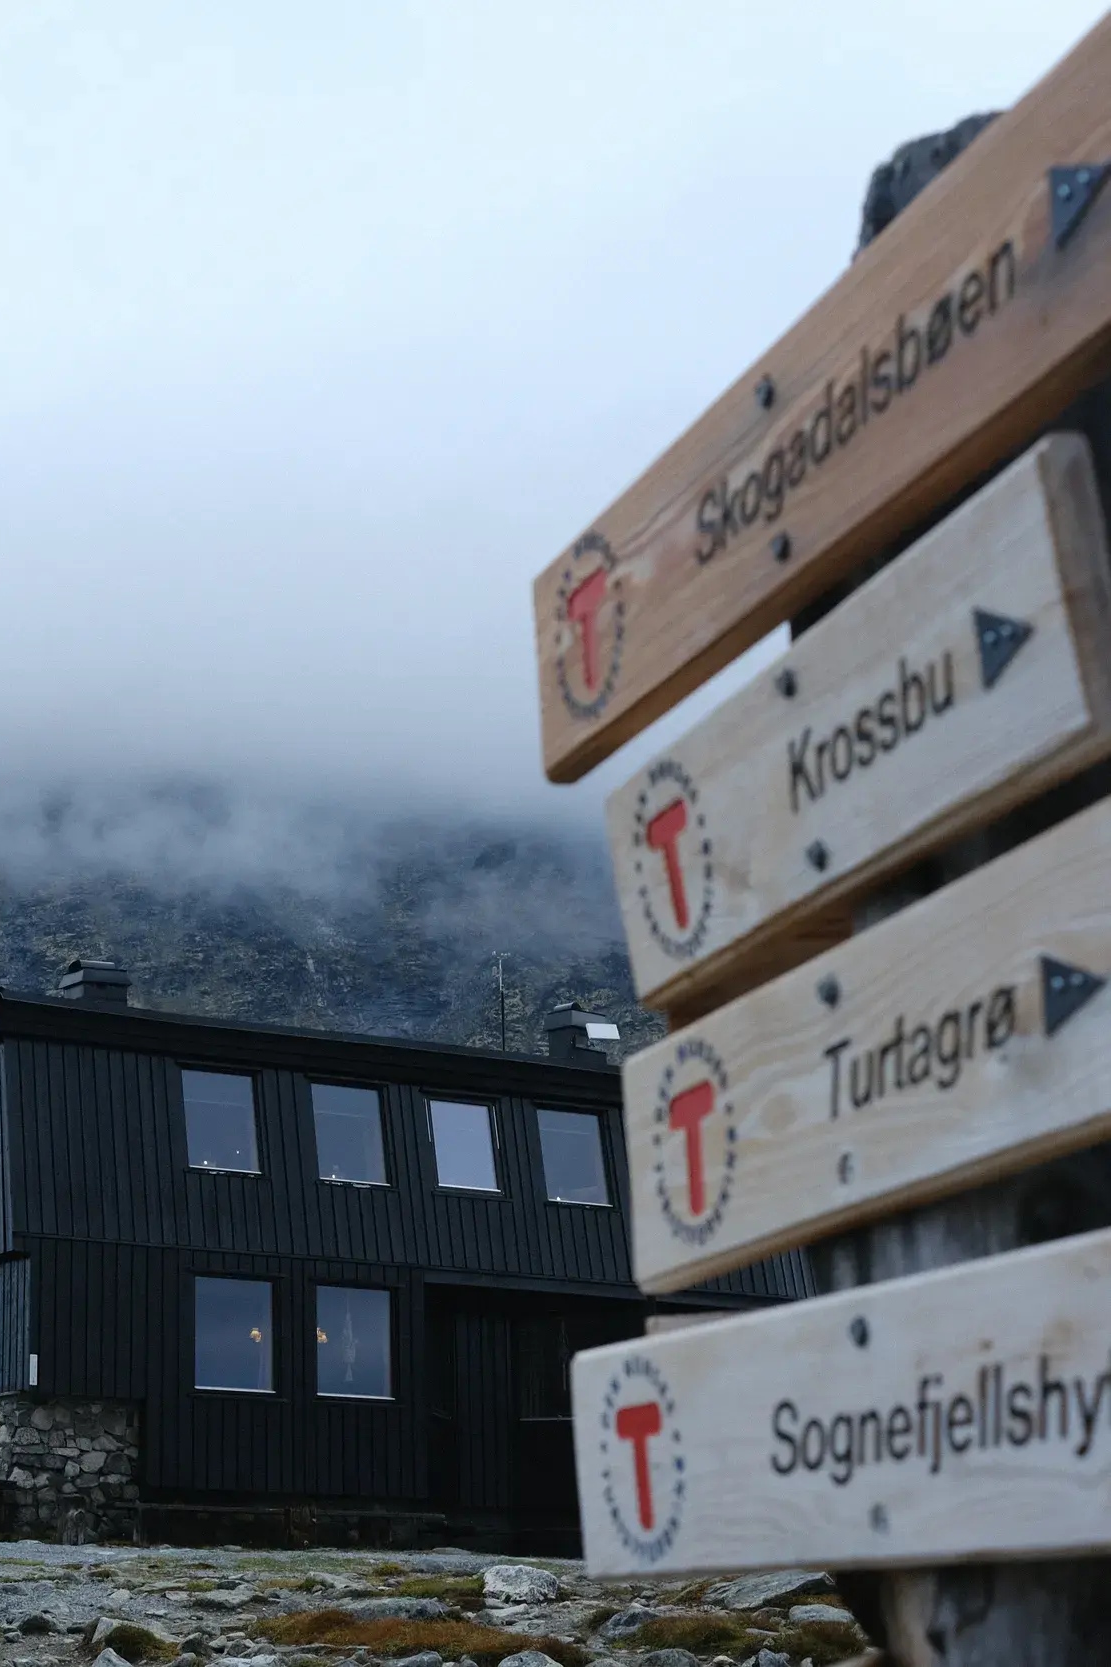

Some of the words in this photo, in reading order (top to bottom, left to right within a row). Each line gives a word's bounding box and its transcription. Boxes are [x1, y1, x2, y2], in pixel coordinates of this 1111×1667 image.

[695, 237, 1017, 566] Skogadalsbøen
[567, 565, 608, 691] T
[787, 650, 955, 815] Krossbu
[646, 797, 689, 930] T
[823, 984, 1017, 1122] Turtagrø
[669, 1078, 715, 1216] T
[616, 1401, 663, 1532] T
